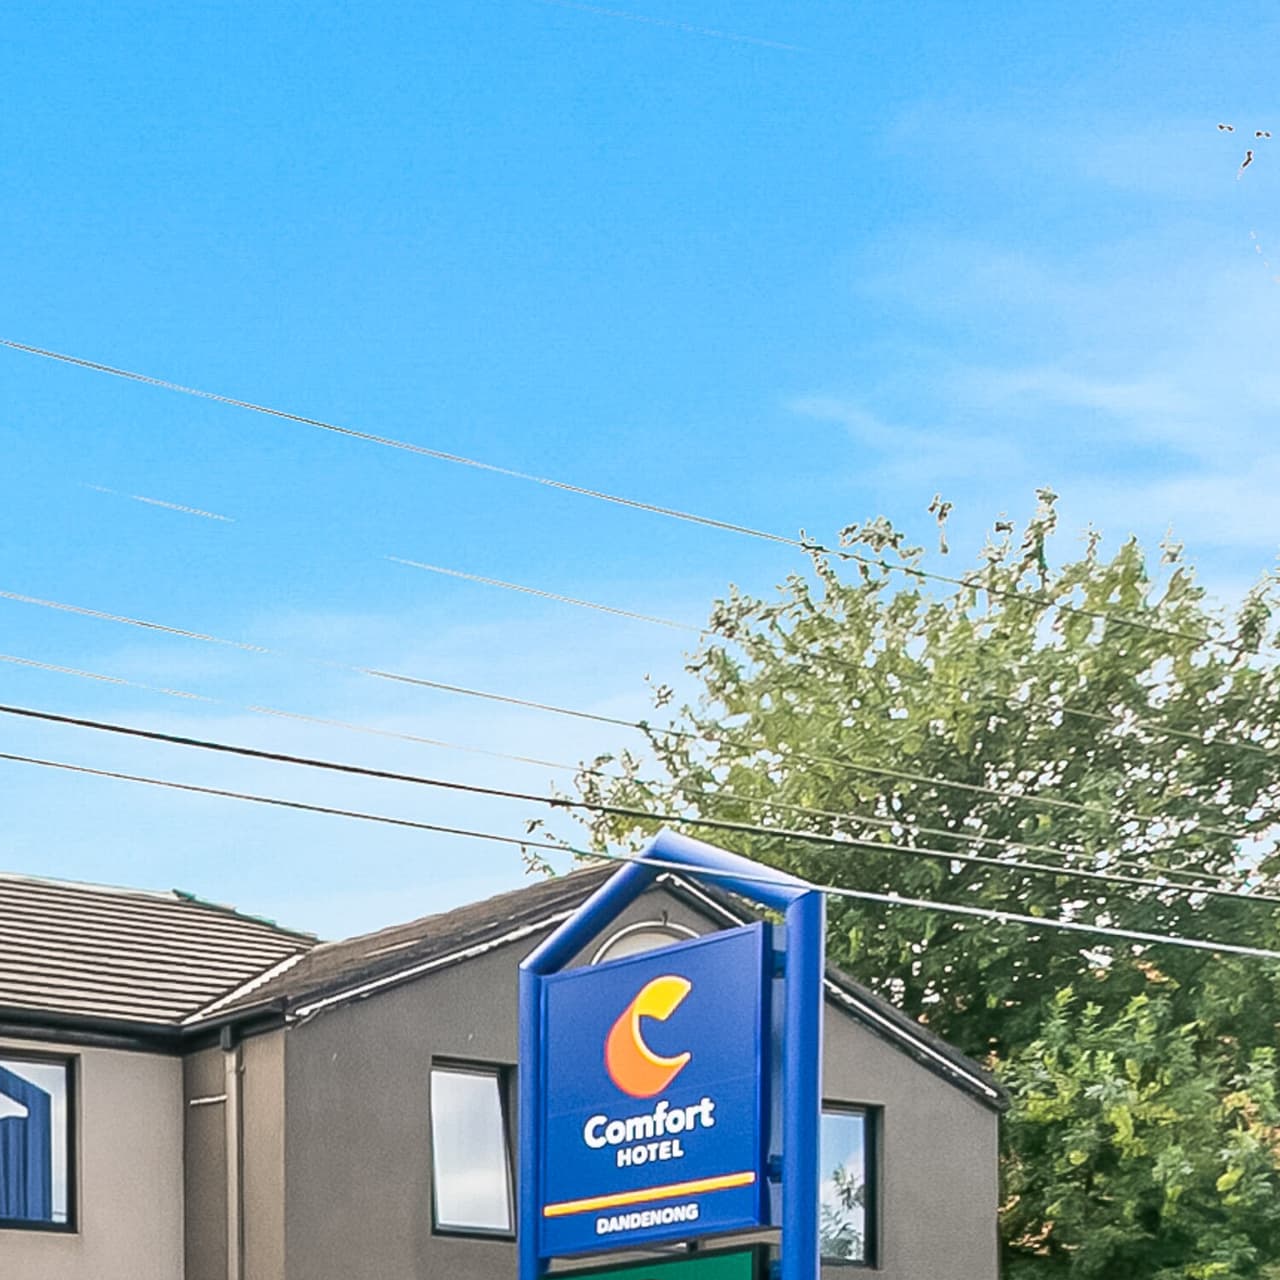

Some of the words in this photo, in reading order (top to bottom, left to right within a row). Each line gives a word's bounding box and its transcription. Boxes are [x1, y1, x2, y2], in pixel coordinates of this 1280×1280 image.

[584, 1097, 715, 1148] Comfort
[616, 1139, 685, 1168] HOTEL
[596, 1203, 700, 1235] DANDENONG
